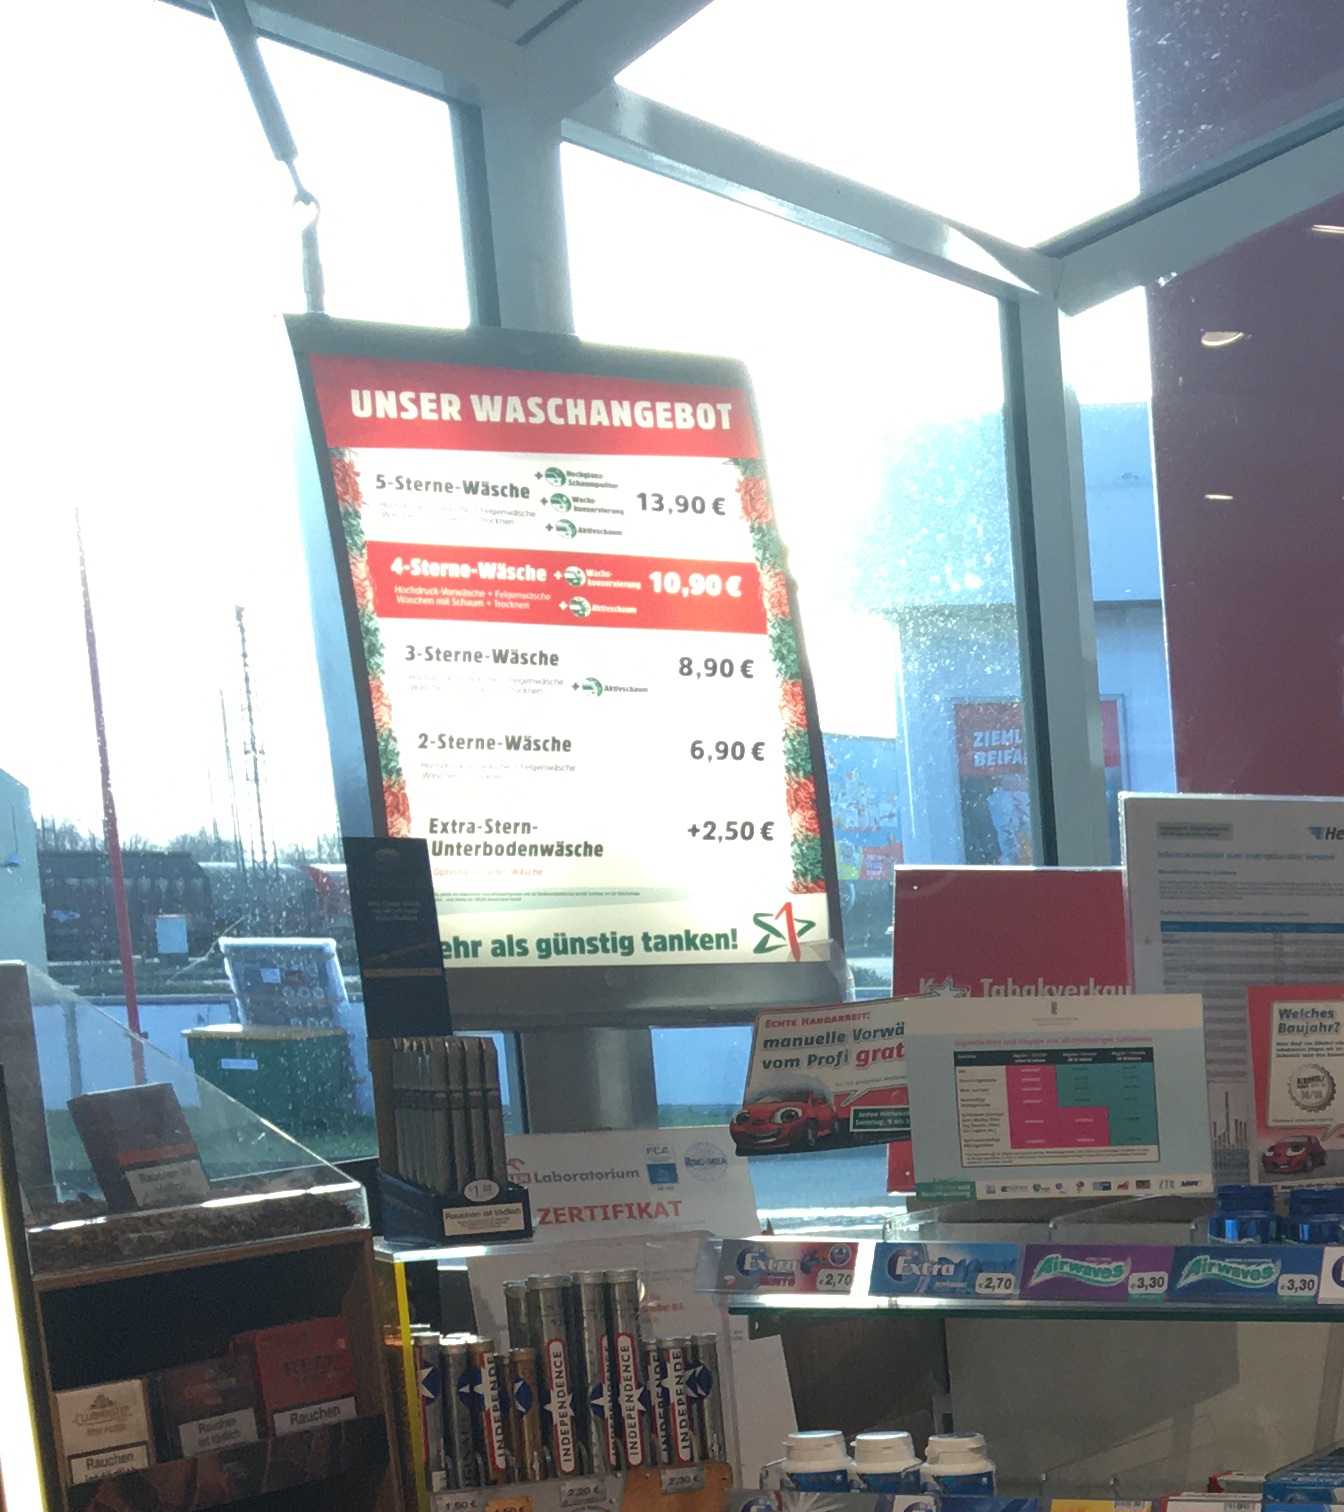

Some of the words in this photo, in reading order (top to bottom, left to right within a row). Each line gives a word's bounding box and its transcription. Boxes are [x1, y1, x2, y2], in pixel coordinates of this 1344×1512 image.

[350, 388, 463, 422] UNSER
[470, 394, 733, 431] WASCHANGEBOT
[375, 474, 531, 500] 5-Sterne-Wäsche
[636, 492, 708, 517] 13,90
[712, 496, 726, 516] €
[390, 557, 547, 582] 4-Sterne-Wäsche
[648, 570, 722, 597] 10,90
[725, 575, 742, 596] €
[404, 644, 560, 666] 3-Sterne-Wäsche
[678, 656, 735, 680] 8,90
[739, 659, 755, 679] €
[417, 732, 572, 755] 2-Sterne-Wäsche
[690, 740, 745, 762] 6,90
[749, 741, 766, 761] €
[428, 816, 539, 837] Extra-Stern-
[687, 820, 758, 842] +2,50
[761, 821, 775, 841] €
[431, 838, 605, 859] Unterbodenwäsche
[490, 933, 530, 959] als
[535, 931, 635, 960] günstig
[640, 929, 739, 953] tanken!
[1278, 1008, 1334, 1020] Welches
[763, 1030, 846, 1049] manuelle
[852, 1022, 905, 1041] Vorwä
[1278, 1021, 1341, 1035] Baujahr?
[762, 1056, 801, 1069] vom
[806, 1050, 849, 1069] Profi
[855, 1043, 905, 1068] grat
[533, 1166, 640, 1184] Laboratorium
[537, 1200, 683, 1225] ZERTIFIKAT
[984, 1274, 1013, 1290] 2,70
[1028, 1254, 1129, 1288] Airwaves
[1136, 1275, 1165, 1290] 3,30
[551, 1350, 573, 1464] INDEPENDENCE
